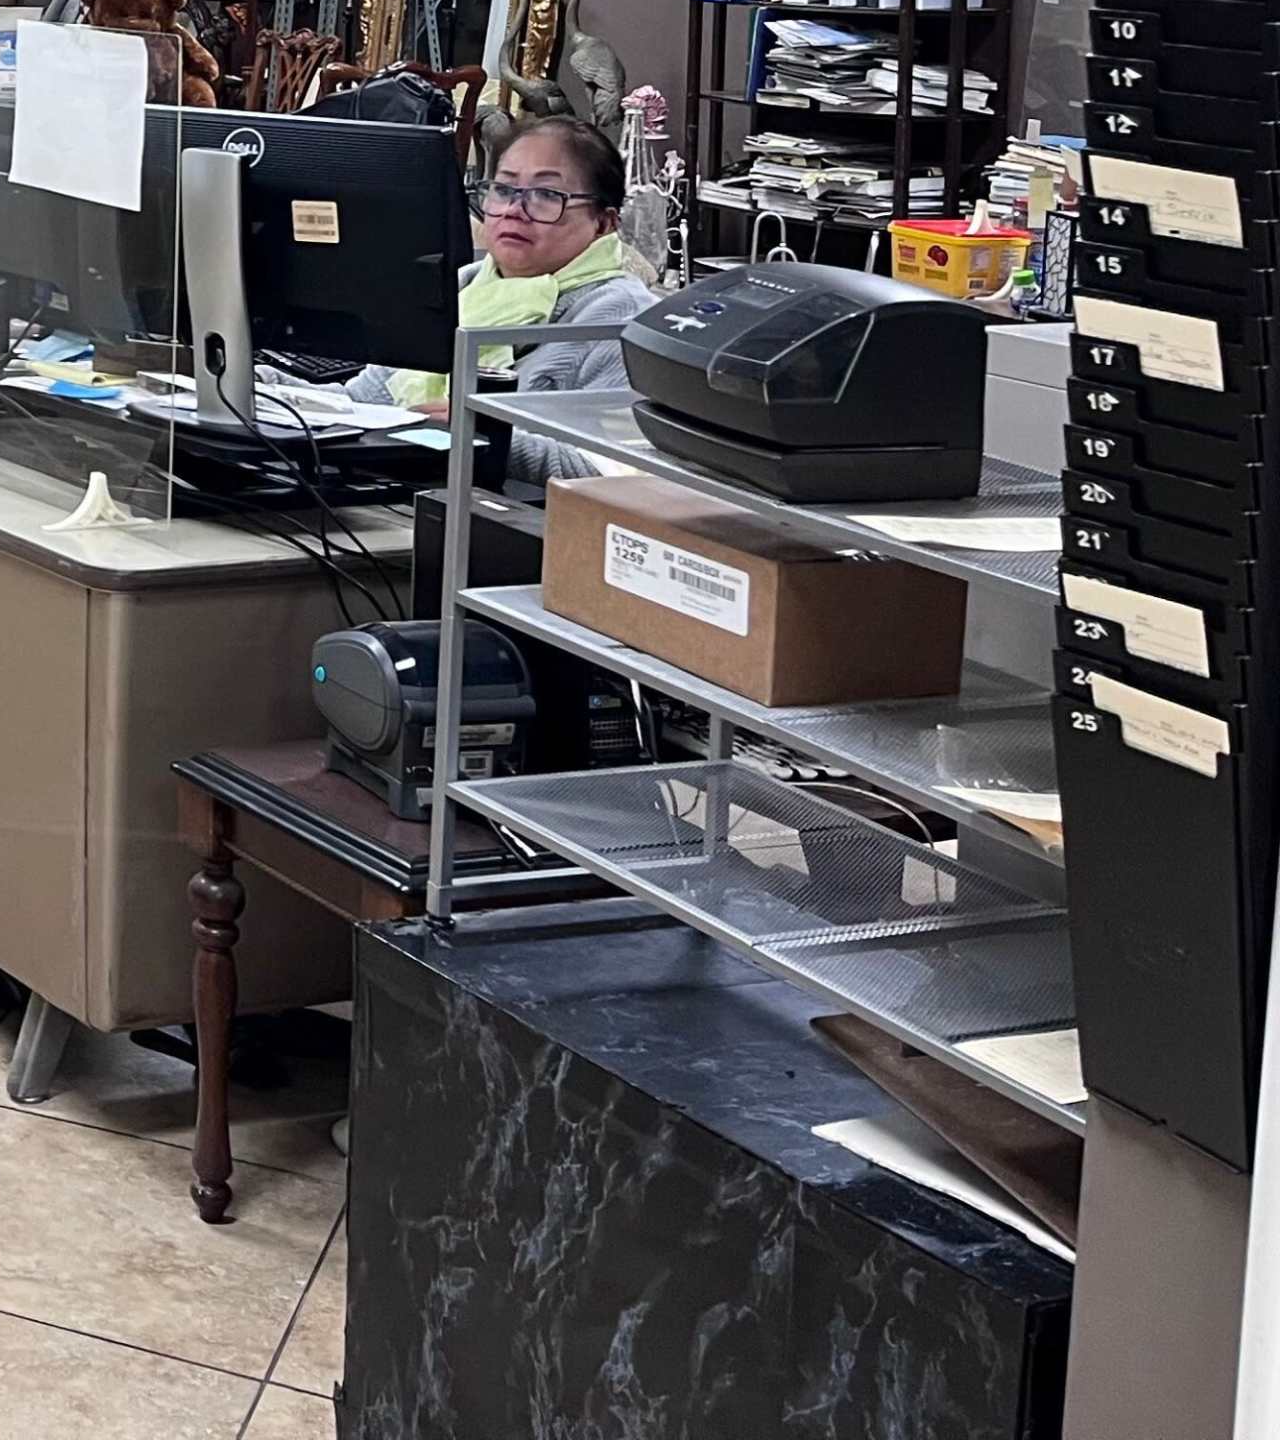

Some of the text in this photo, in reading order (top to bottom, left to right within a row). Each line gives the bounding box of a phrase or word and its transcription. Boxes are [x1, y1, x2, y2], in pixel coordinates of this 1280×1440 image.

[1110, 21, 1136, 39] 10
[1109, 68, 1134, 87] 11
[1105, 115, 1132, 134] 12
[1099, 207, 1126, 226] 14
[1095, 254, 1122, 274] 15
[1090, 347, 1115, 366] 17
[1087, 392, 1113, 411] 18
[1083, 438, 1109, 458] 19
[1080, 483, 1107, 503] 20
[1075, 530, 1101, 550] 21
[614, 546, 645, 566] 1259
[1073, 619, 1101, 639] 23
[1071, 712, 1098, 732] 25
